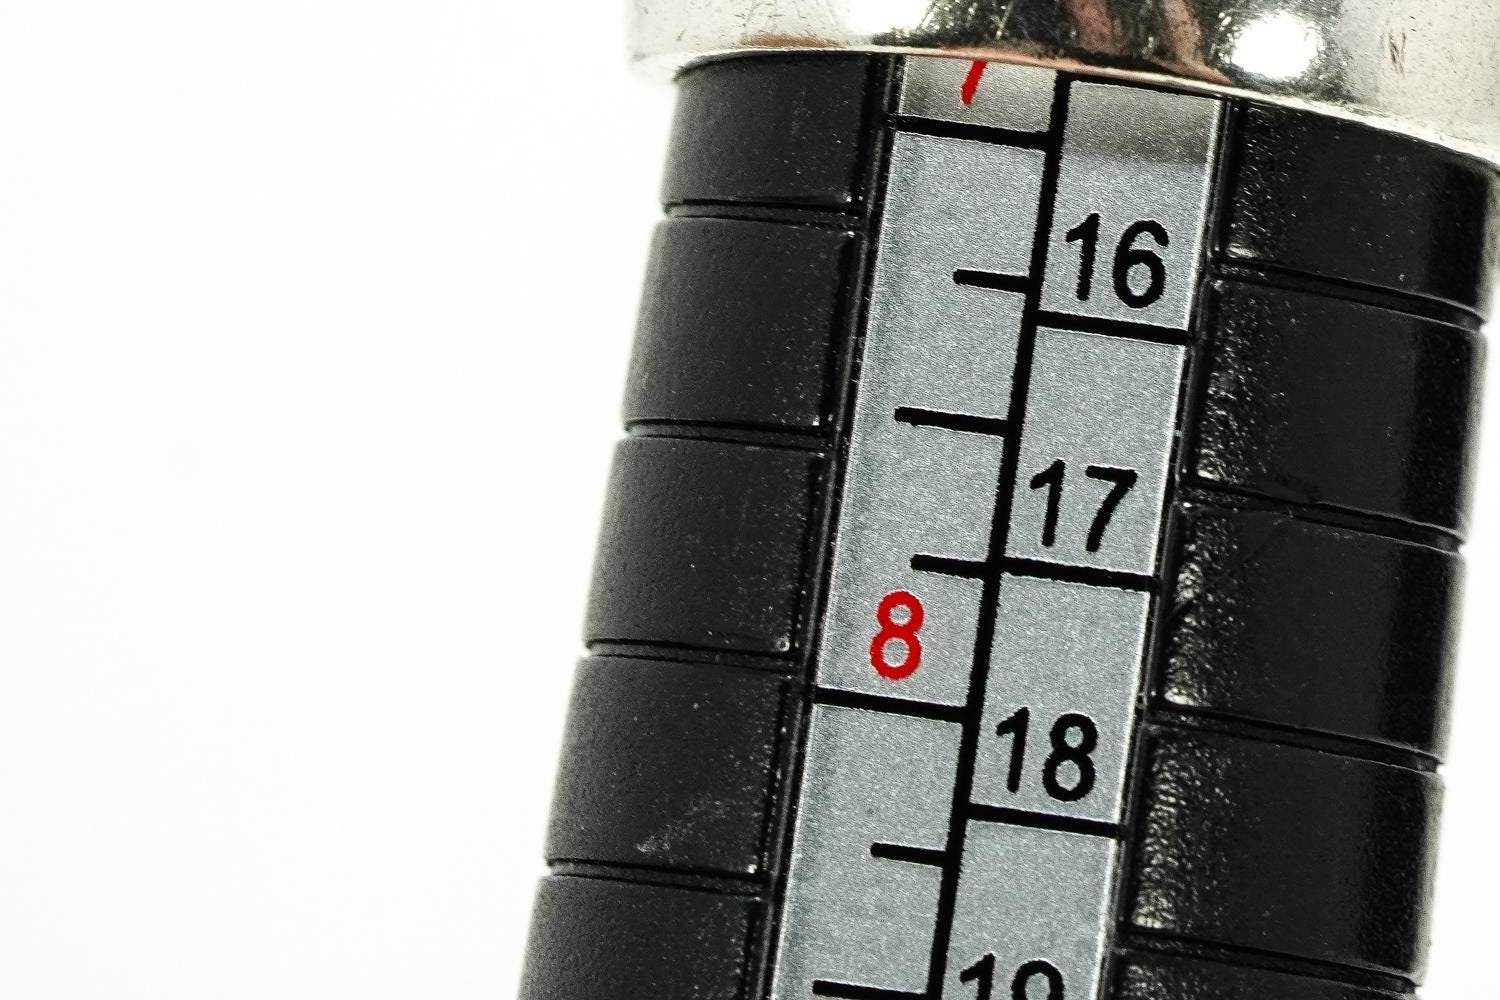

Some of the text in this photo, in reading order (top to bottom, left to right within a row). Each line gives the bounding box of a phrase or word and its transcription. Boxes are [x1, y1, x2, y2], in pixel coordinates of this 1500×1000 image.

[1064, 212, 1170, 308] 16
[1028, 458, 1139, 554] 17
[869, 590, 925, 681] 8
[995, 706, 1100, 803] 18
